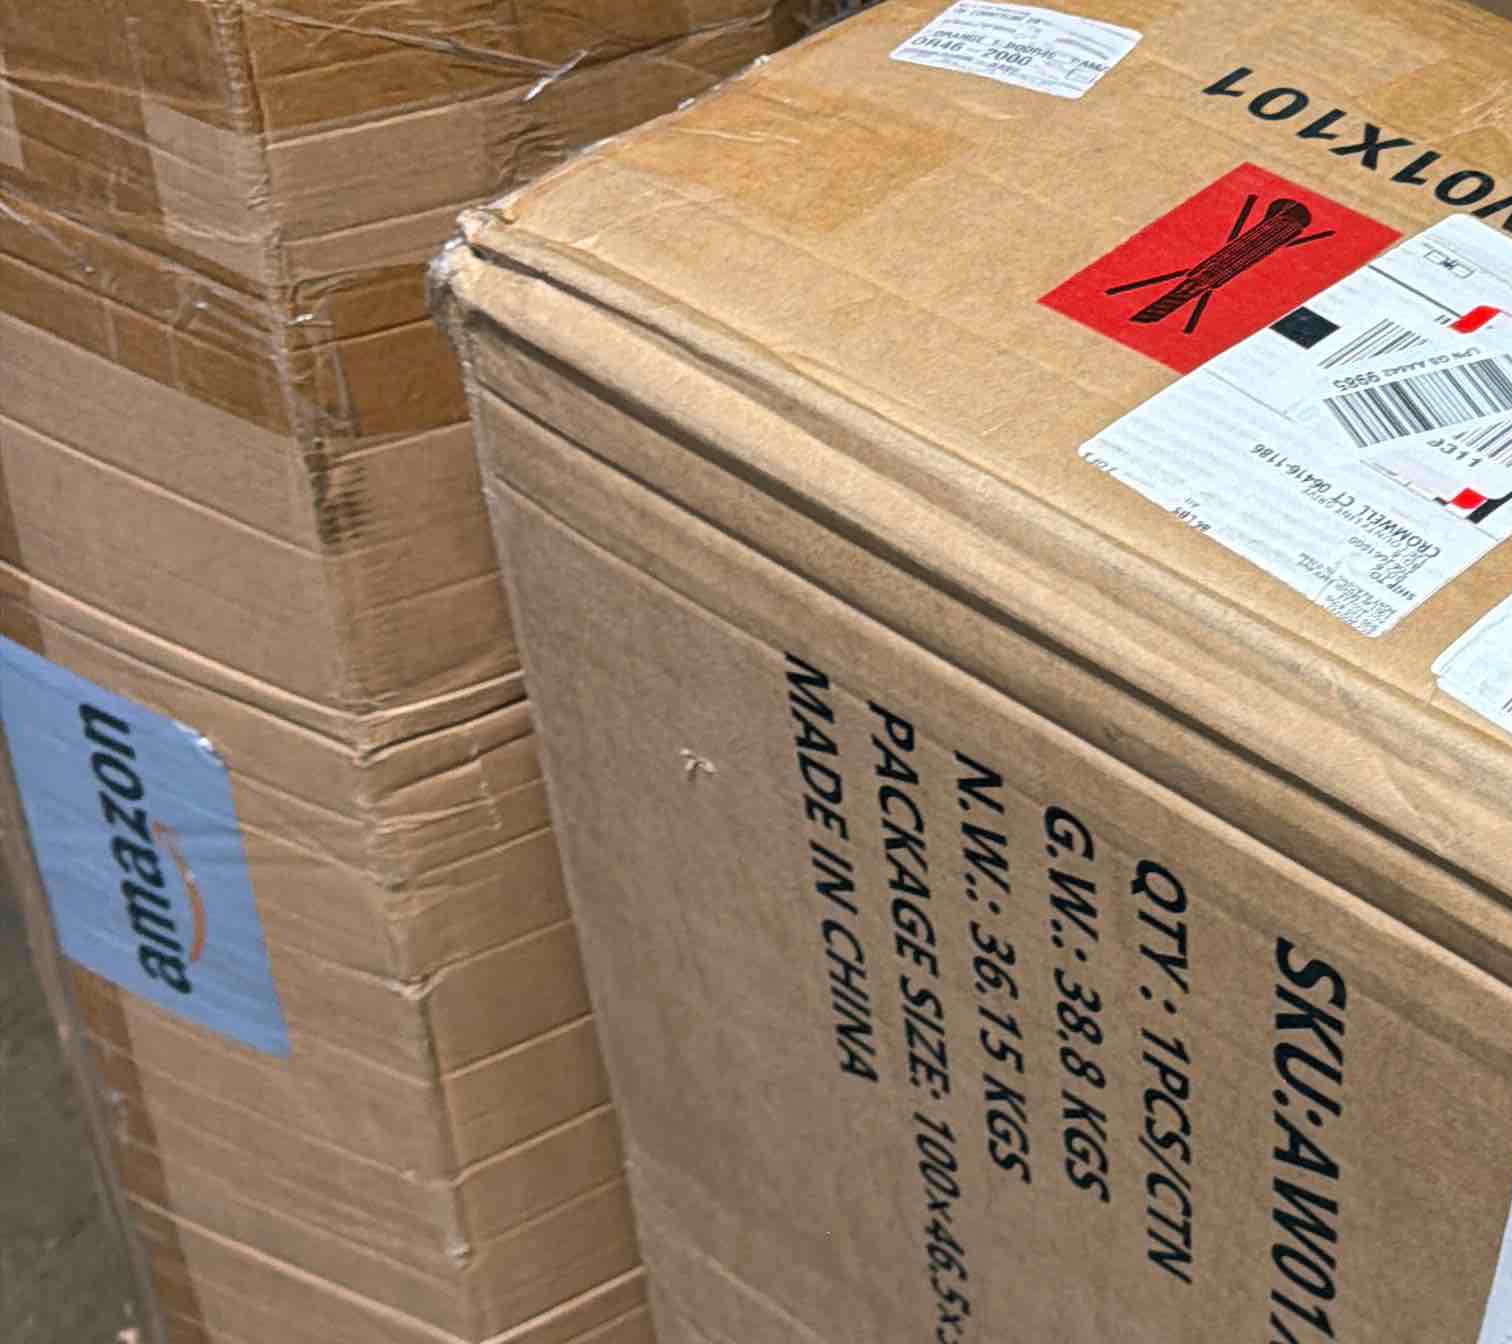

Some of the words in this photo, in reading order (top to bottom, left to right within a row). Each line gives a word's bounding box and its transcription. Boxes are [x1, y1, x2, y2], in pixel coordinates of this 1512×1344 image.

[1331, 369, 1381, 392] 9985
[1247, 442, 1334, 494] 06416-1186
[1330, 490, 1358, 508] CT
[1352, 503, 1444, 560] CROMWELL
[784, 651, 851, 842] MADE
[79, 703, 192, 994] amazon
[809, 840, 859, 915] IN
[867, 699, 940, 978] PACKAGE
[821, 919, 878, 1083] CHINA
[900, 975, 951, 1101] SIZE:
[969, 920, 1025, 1073] 36.15
[1054, 968, 1106, 1089] 38.8
[983, 1073, 1031, 1184] KGS
[1061, 1089, 1111, 1203] KGS
[1138, 1028, 1193, 1285] 1PCS/CTN
